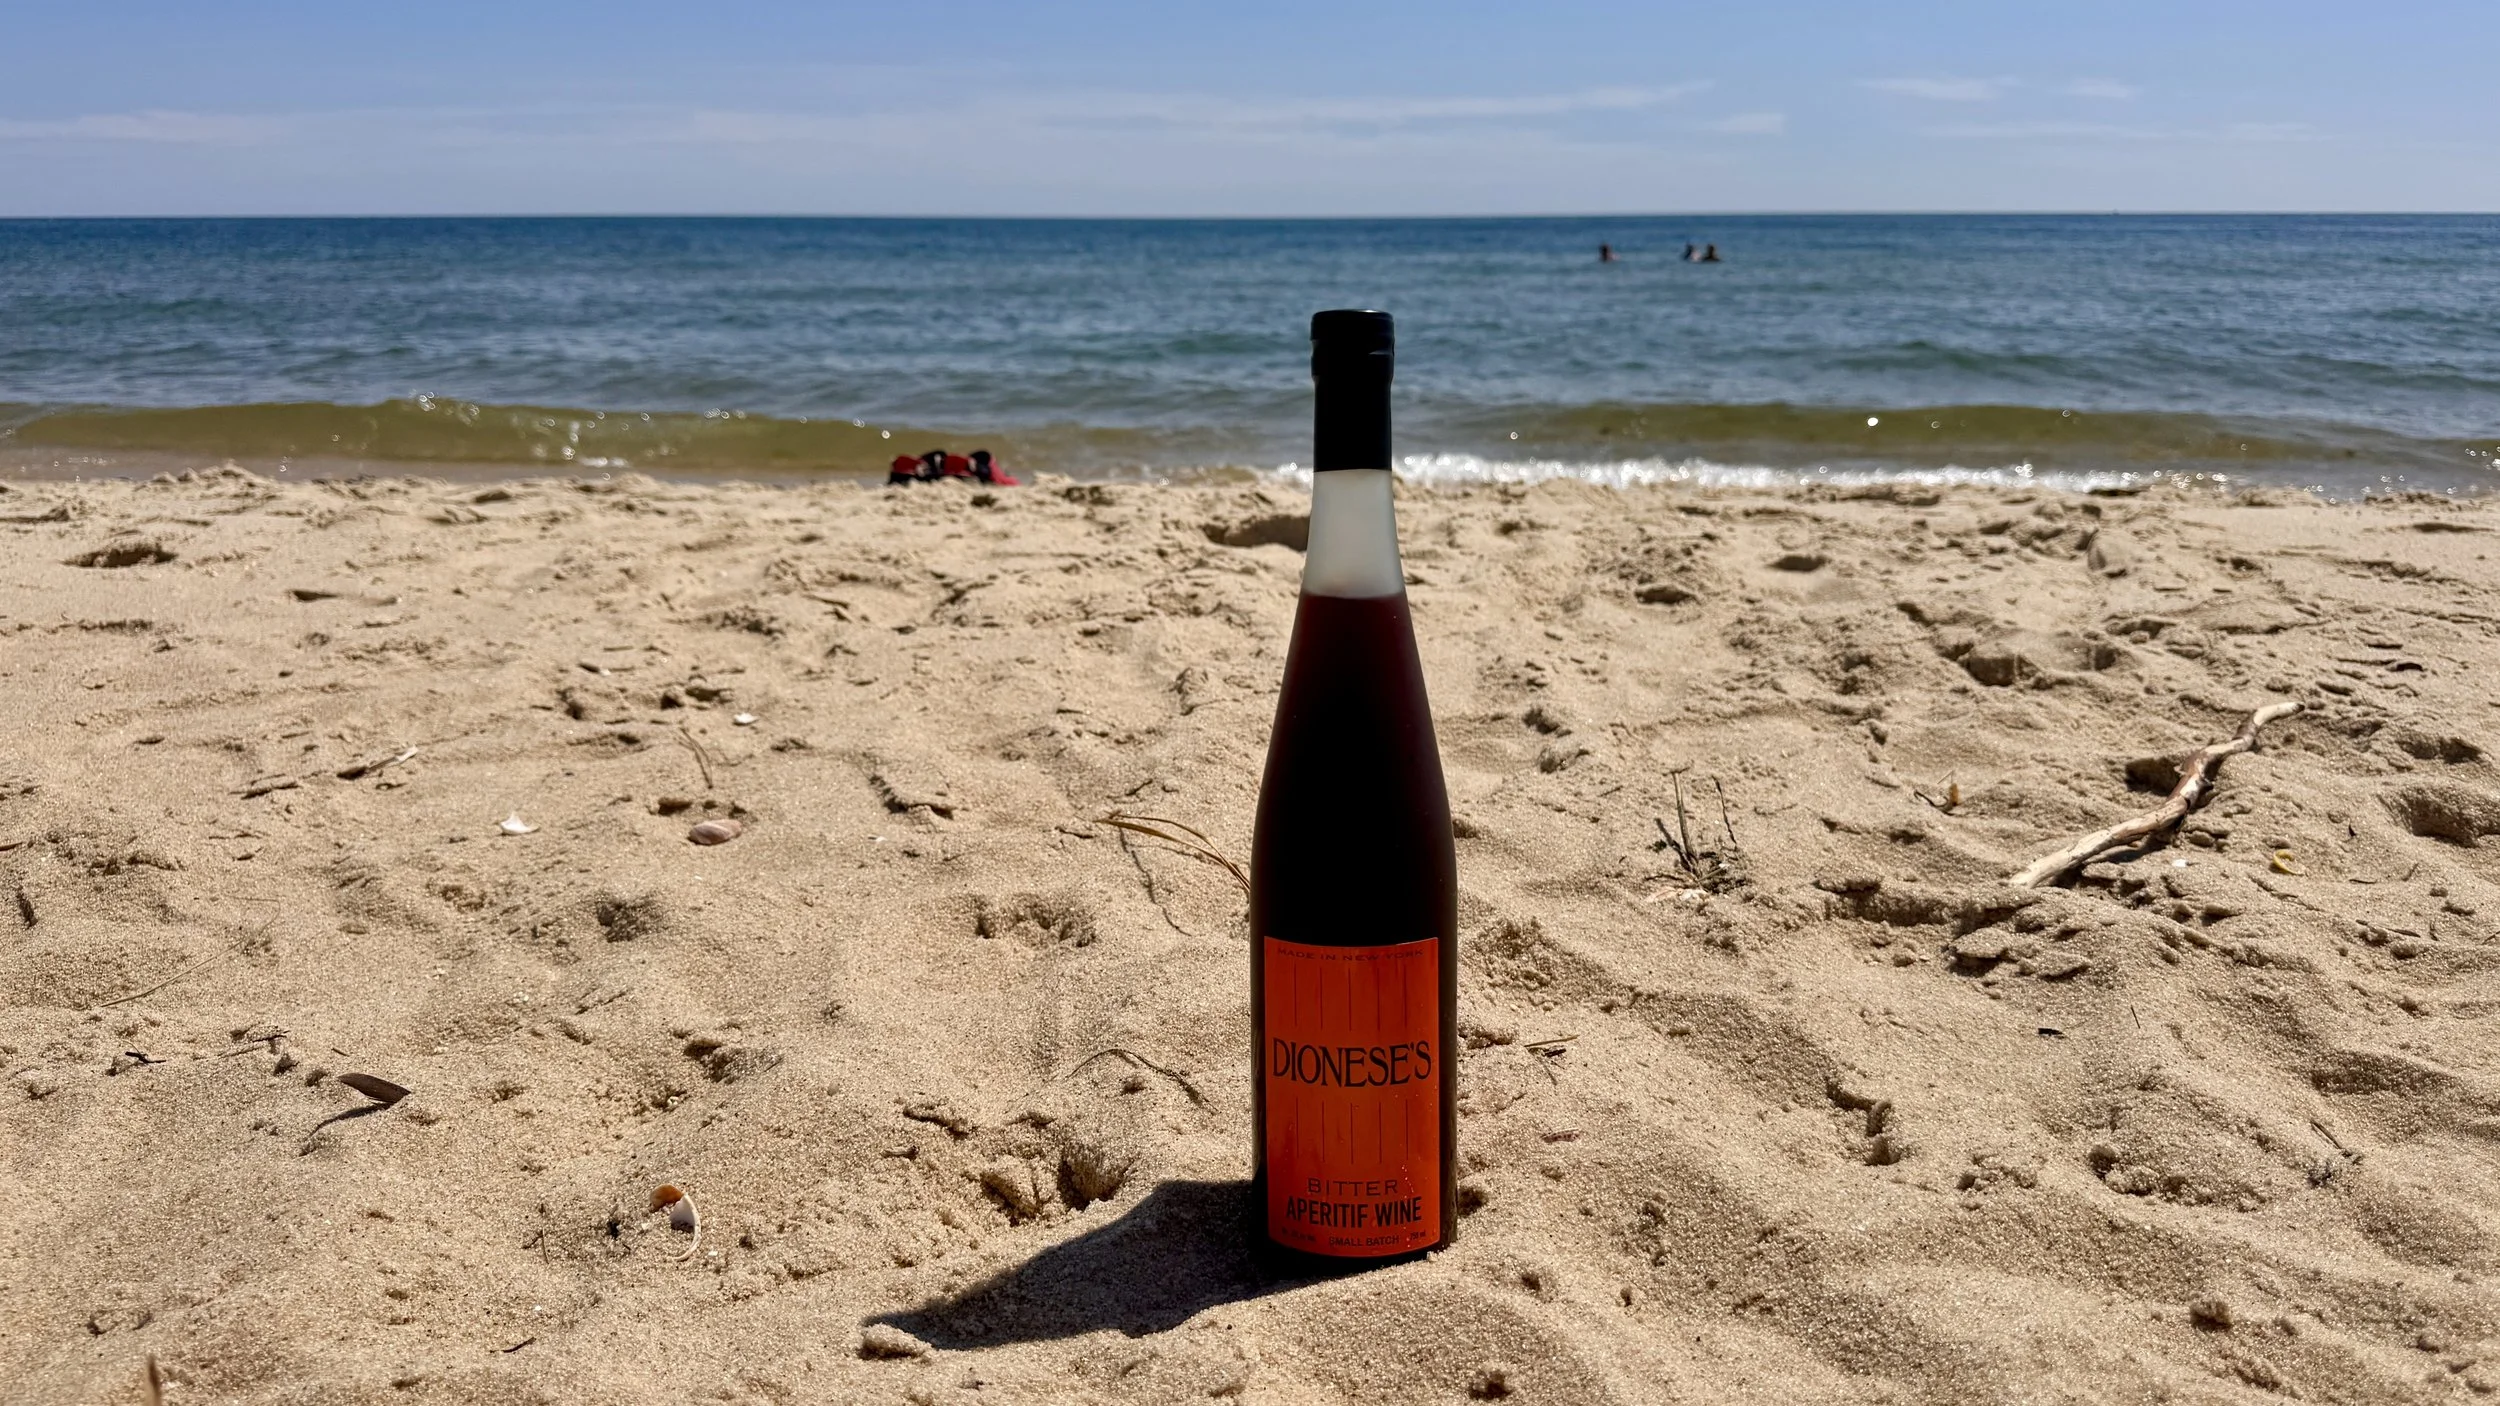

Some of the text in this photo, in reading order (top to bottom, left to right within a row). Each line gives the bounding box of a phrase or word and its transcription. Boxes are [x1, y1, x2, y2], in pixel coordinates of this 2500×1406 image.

[1277, 947, 1424, 961] MADE IN NEW YORK
[1272, 1037, 1432, 1088] DIONESE'S
[1307, 1177, 1398, 1197] BITTER
[1286, 1196, 1422, 1228] APERITIF WINE
[1329, 1235, 1363, 1247] SMALL
[1366, 1234, 1400, 1247] BATCH
